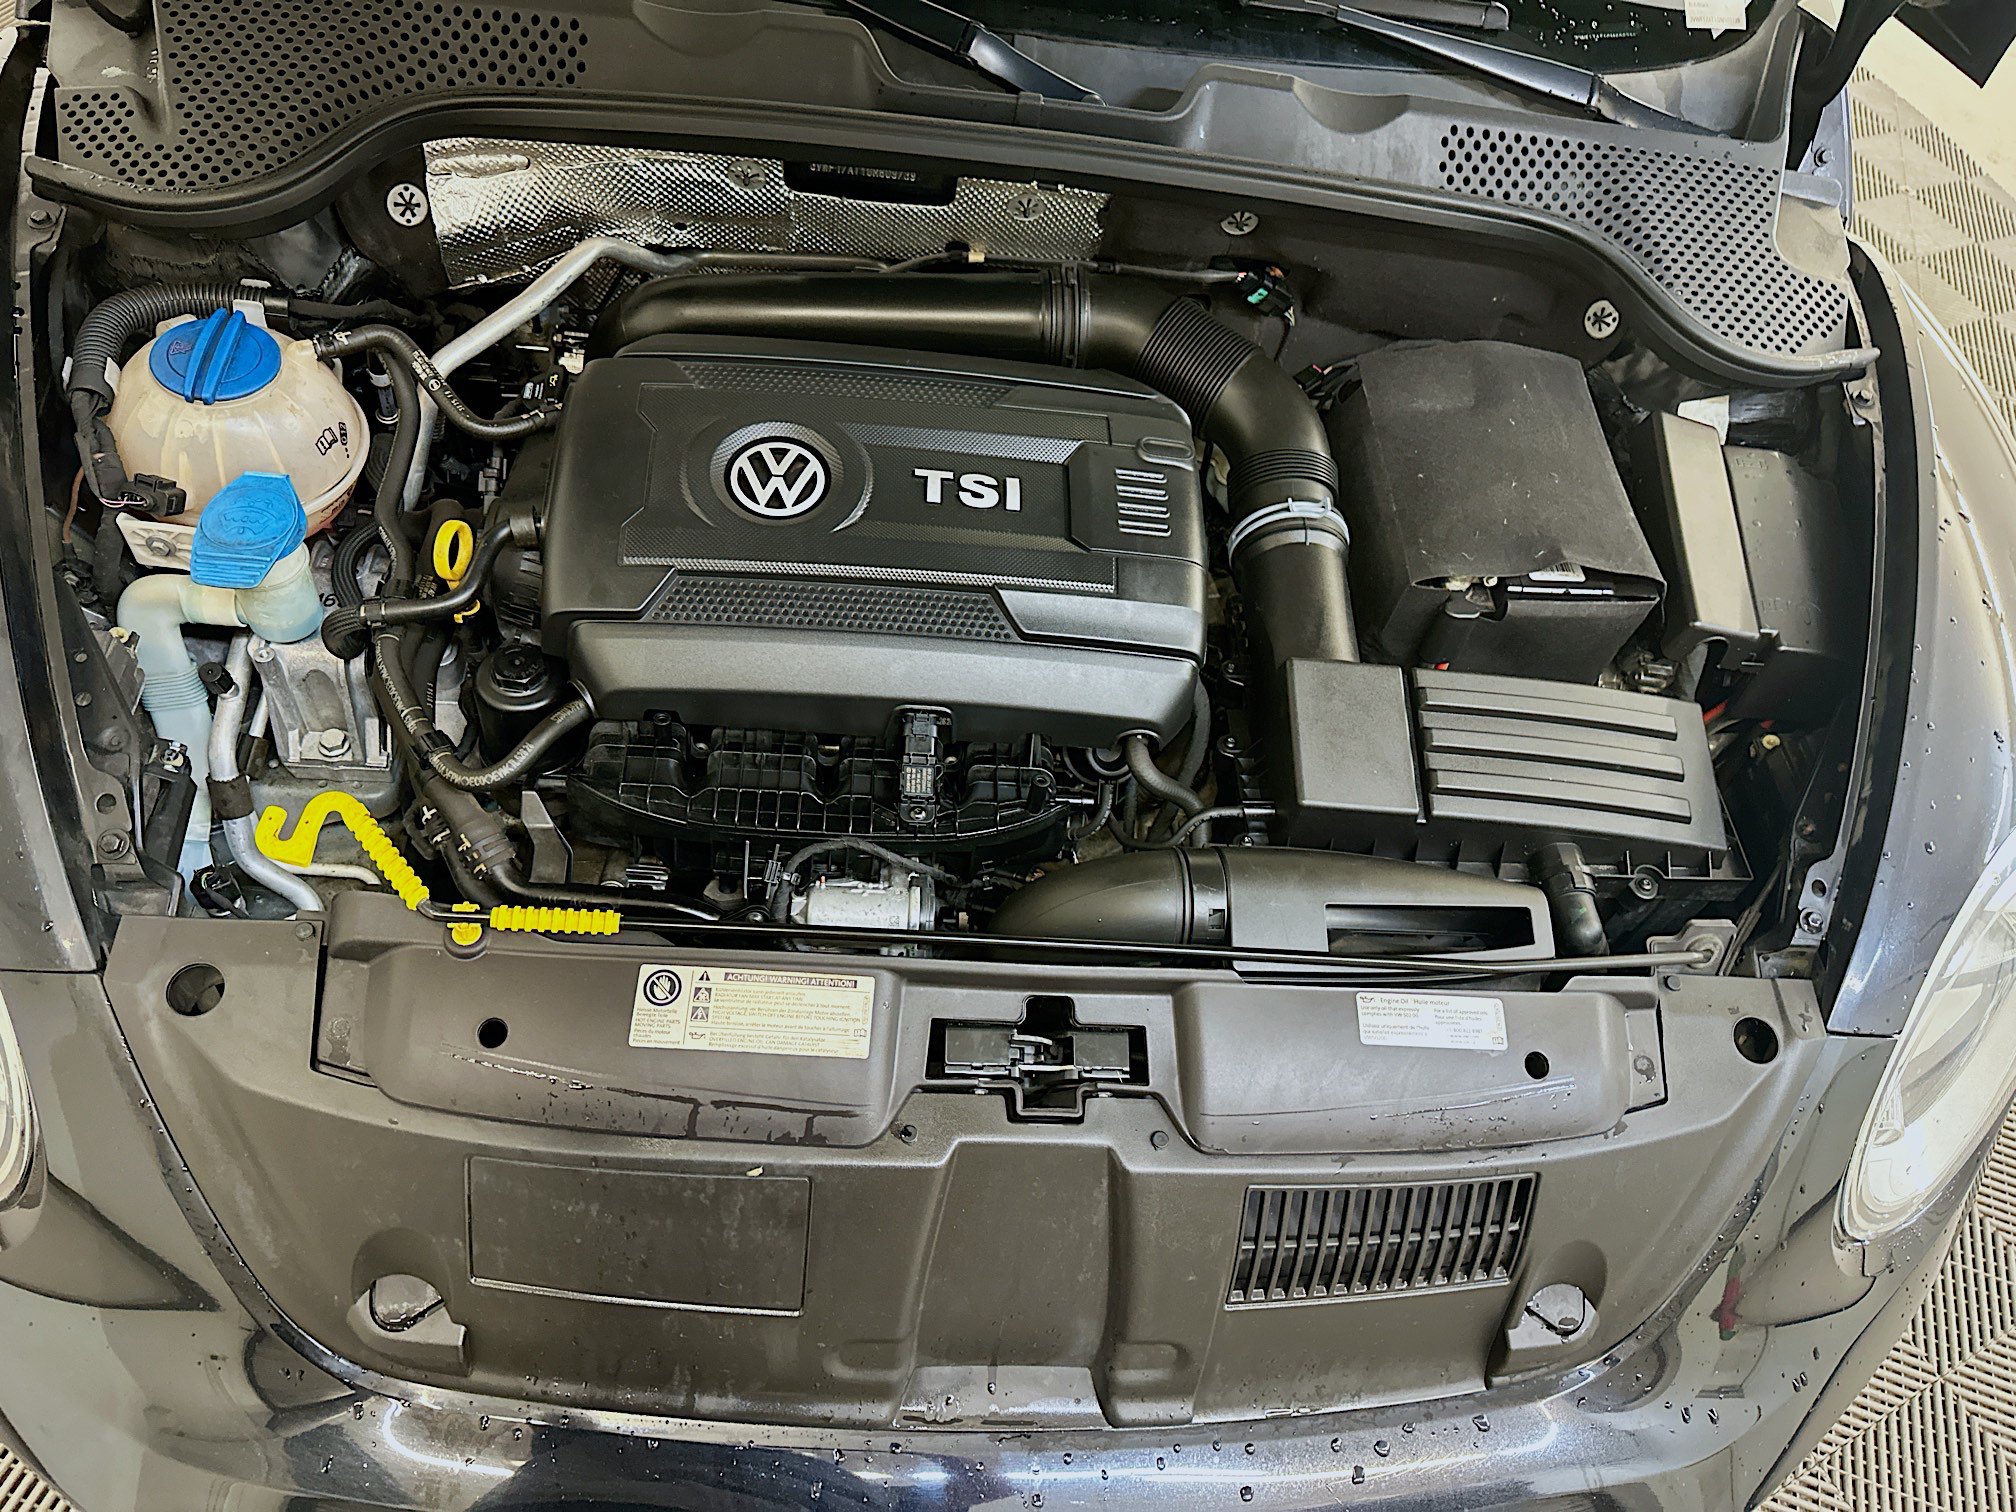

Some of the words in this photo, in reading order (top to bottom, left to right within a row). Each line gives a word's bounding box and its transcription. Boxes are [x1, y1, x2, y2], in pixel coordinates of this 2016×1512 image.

[914, 467, 1021, 512] TSI
[727, 973, 768, 983] ACHTUNG!
[770, 975, 809, 985] WARNING!
[811, 978, 855, 988] ATTENTION!
